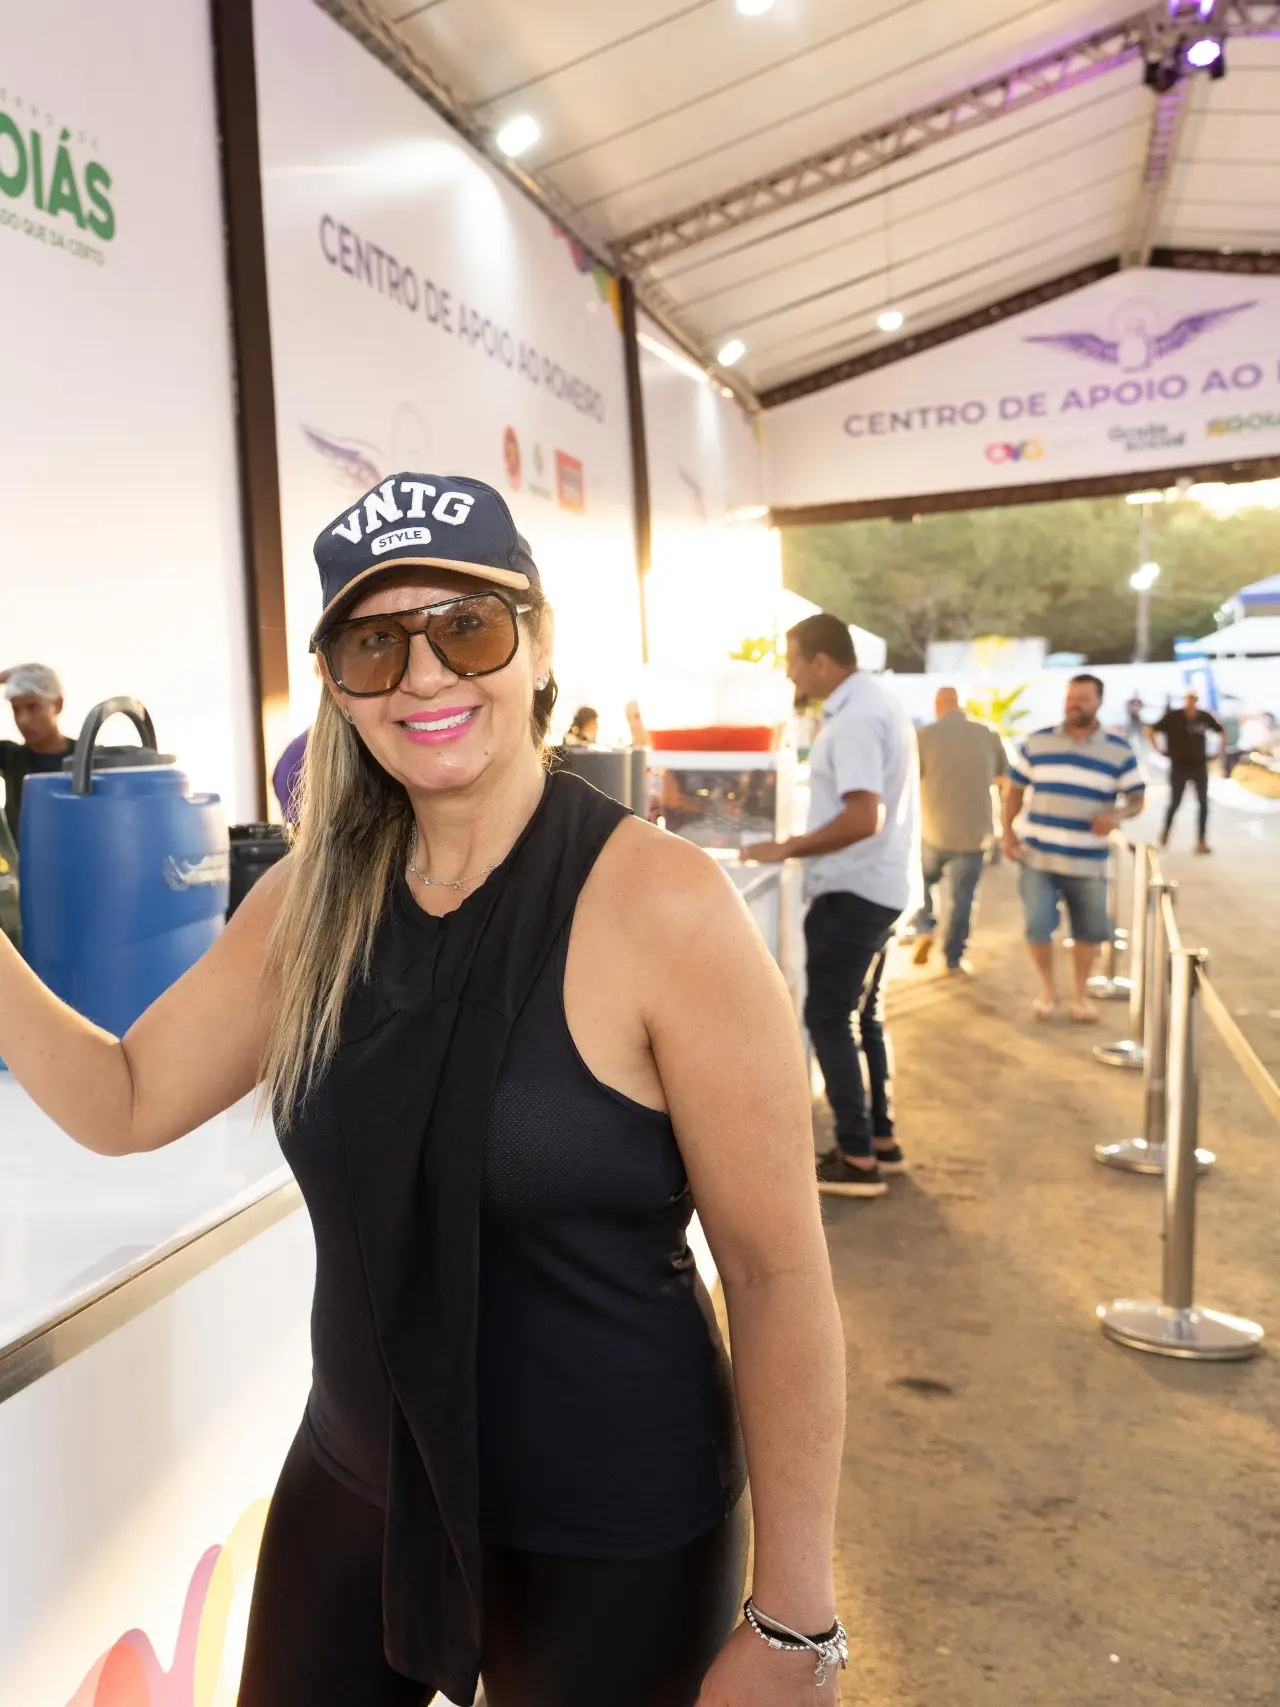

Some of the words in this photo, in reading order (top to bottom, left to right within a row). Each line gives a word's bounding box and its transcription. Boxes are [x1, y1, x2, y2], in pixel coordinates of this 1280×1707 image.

[318, 213, 420, 312] CENTRO
[422, 278, 453, 335] DE
[457, 302, 515, 370] APOIO
[843, 400, 987, 438] CENTRO
[998, 391, 1048, 421] DE
[1059, 373, 1189, 415] APOIO
[1201, 362, 1264, 395] AO
[332, 479, 475, 544] VNTG
[378, 529, 423, 548] STYLE
